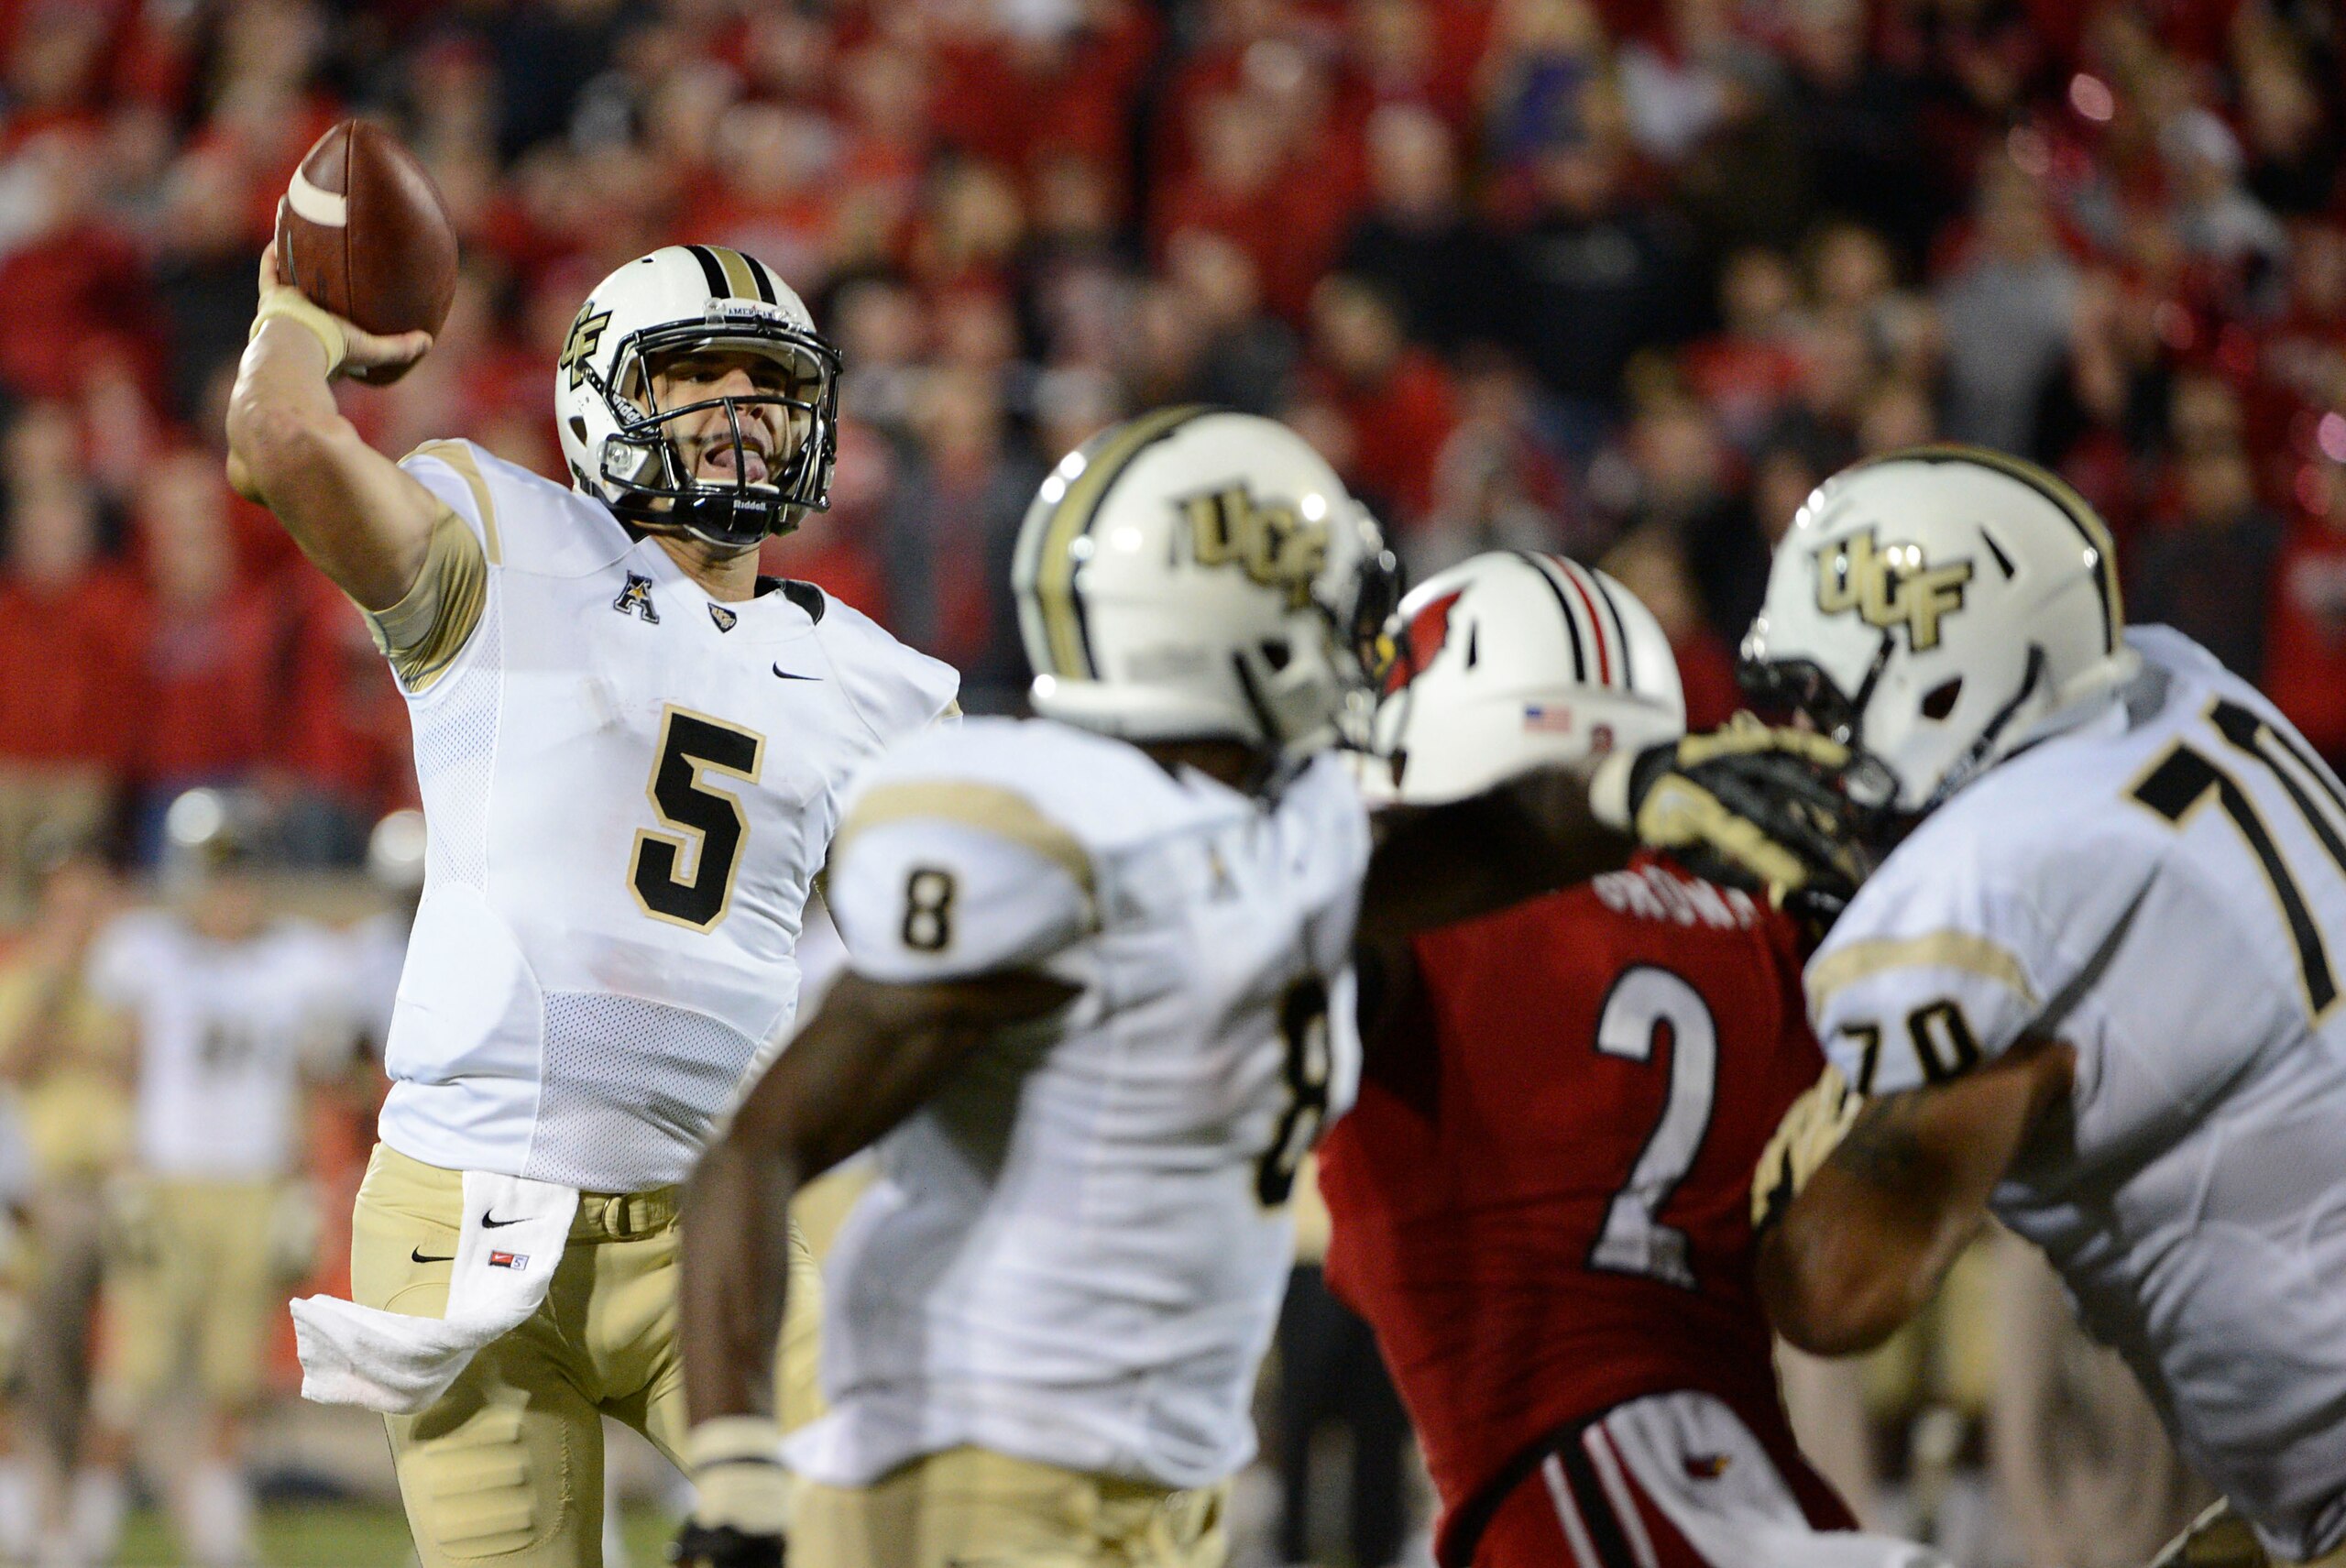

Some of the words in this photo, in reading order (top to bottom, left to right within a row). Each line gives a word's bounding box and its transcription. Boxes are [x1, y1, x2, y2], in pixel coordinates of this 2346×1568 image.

[560, 300, 613, 392] CF
[733, 499, 767, 511] Riddell
[1813, 525, 1975, 655] UCF
[627, 702, 766, 936] 5
[901, 869, 955, 953] 8
[1255, 973, 1329, 1210] 8
[1835, 999, 1985, 1102] 70
[1587, 963, 1716, 1289] 2
